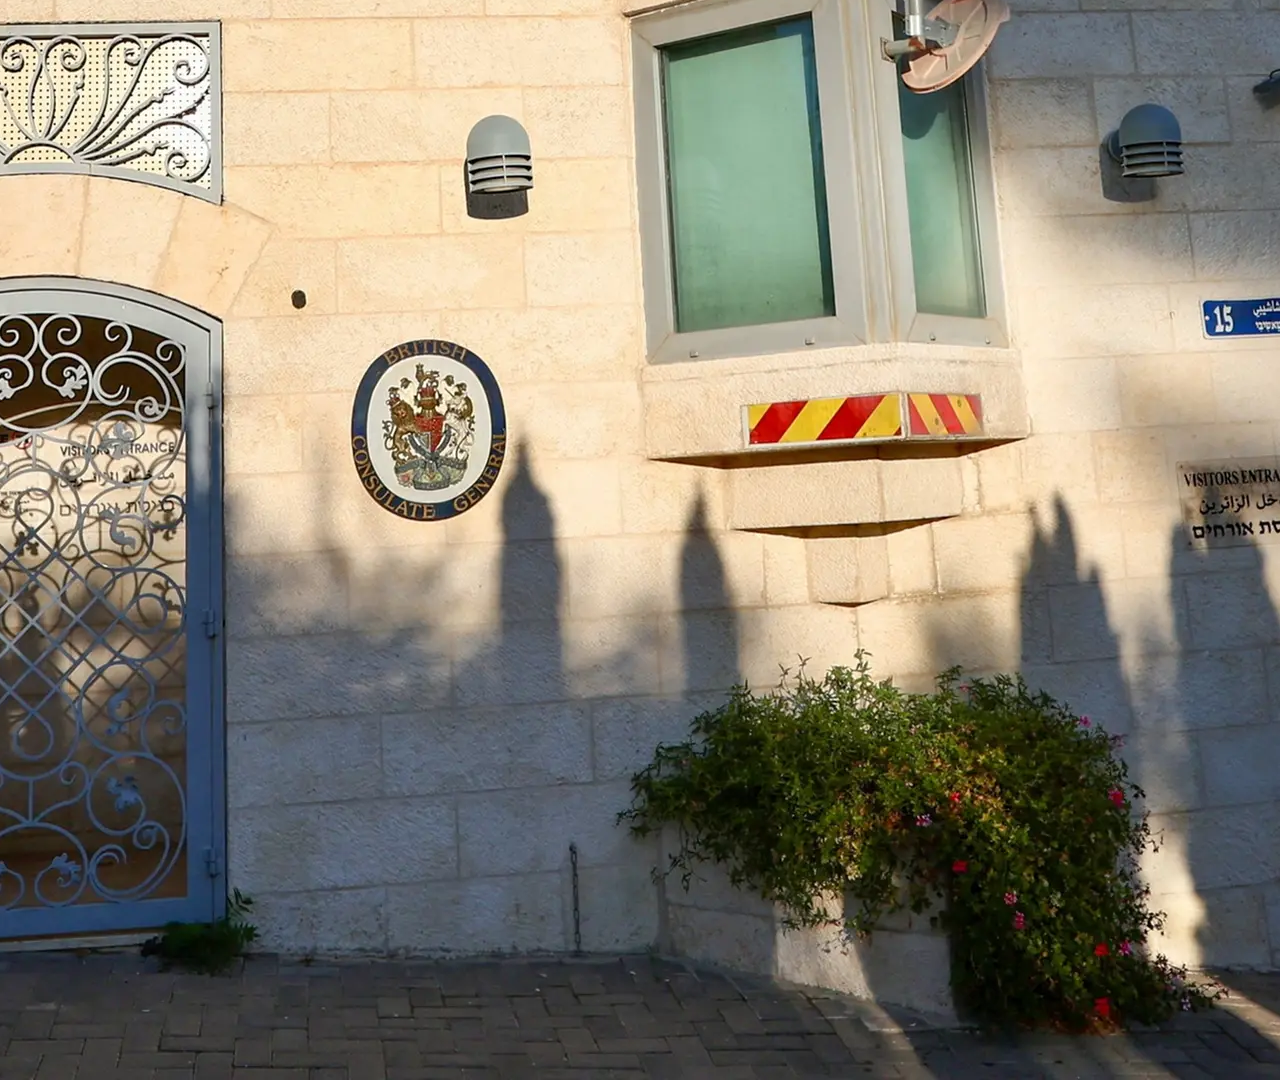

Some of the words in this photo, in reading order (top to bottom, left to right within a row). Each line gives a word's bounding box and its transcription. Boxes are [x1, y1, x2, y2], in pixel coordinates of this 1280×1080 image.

[1214, 304, 1234, 332] 15
[383, 342, 467, 364] BRITISH
[353, 435, 435, 518] CONSULATE
[454, 428, 506, 511] GENERAL
[1184, 470, 1239, 487] VISITORS
[1199, 494, 1250, 515] الزائرين
[1192, 521, 1254, 538] אורחים
